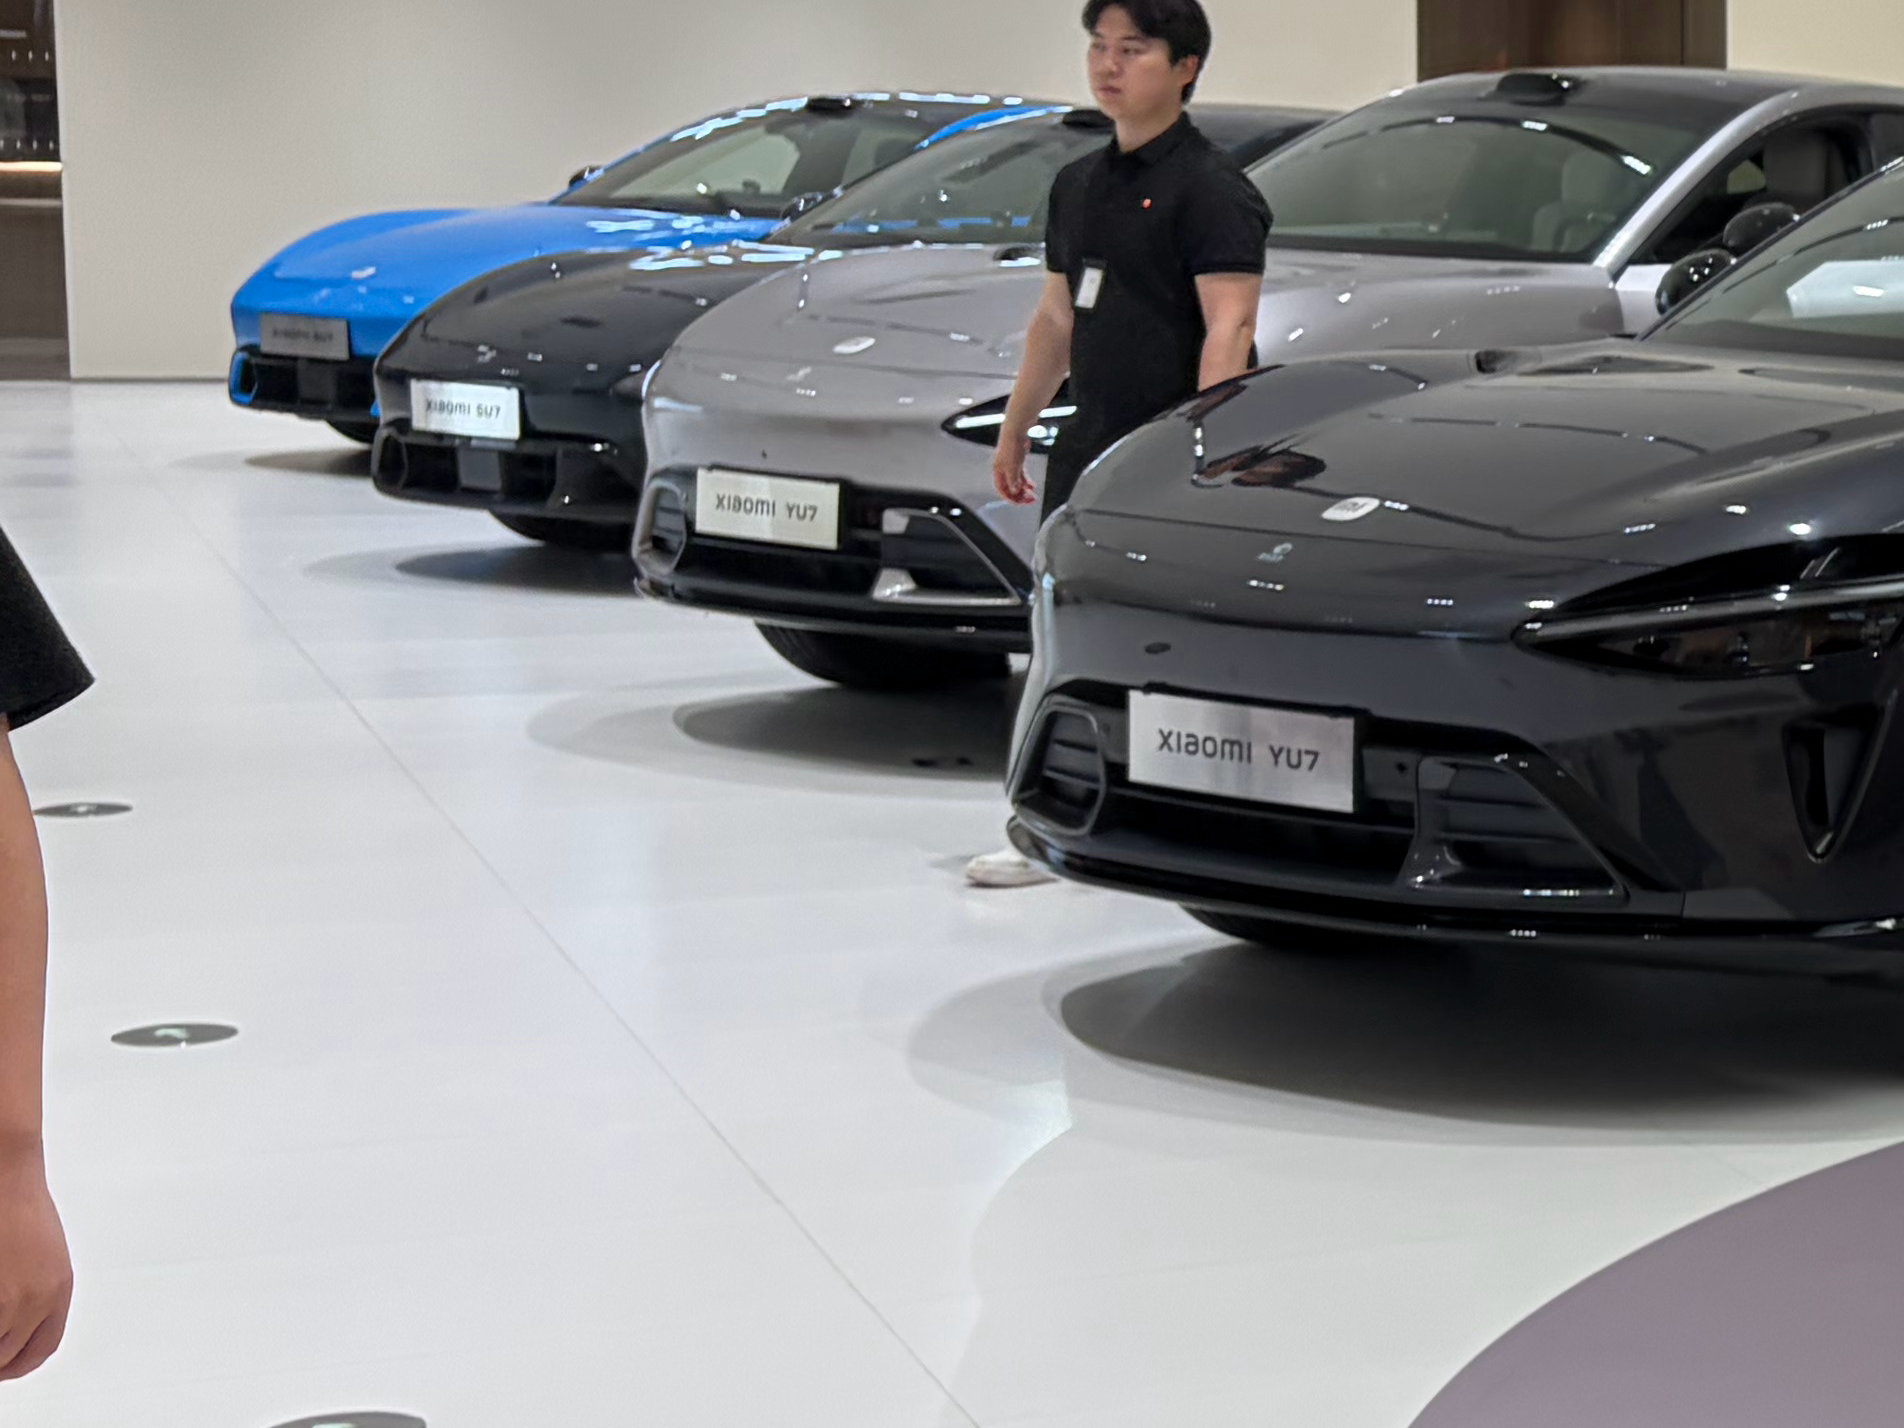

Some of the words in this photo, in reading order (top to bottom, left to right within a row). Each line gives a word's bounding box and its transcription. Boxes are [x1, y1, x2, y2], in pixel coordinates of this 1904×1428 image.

[716, 493, 776, 518] xiaomi
[786, 501, 818, 522] YU7
[1157, 729, 1253, 764] xiaomi
[1268, 744, 1320, 772] YU7
